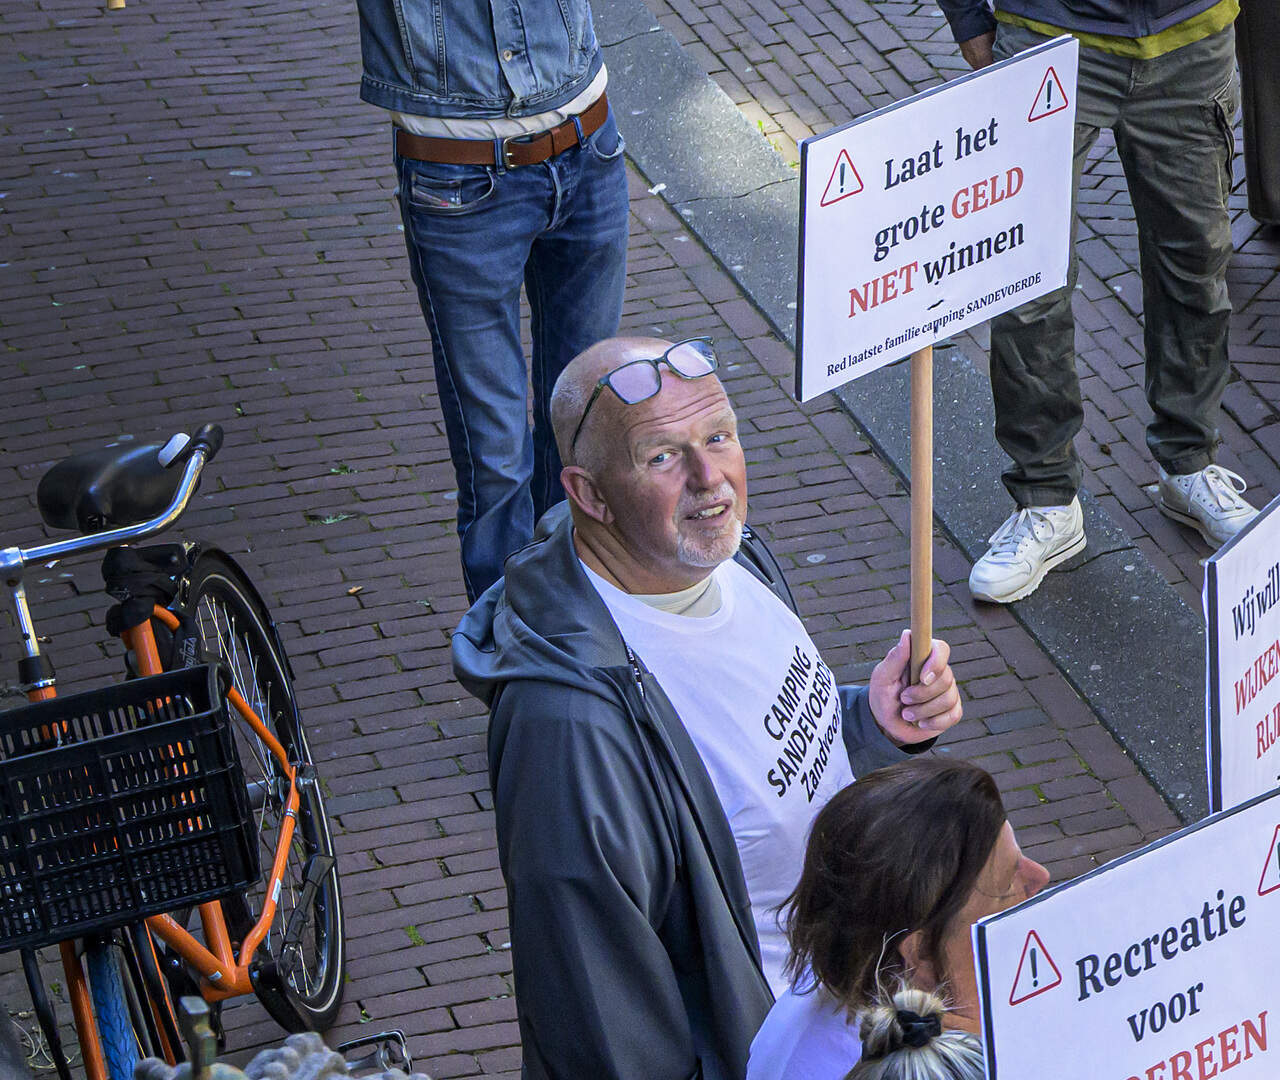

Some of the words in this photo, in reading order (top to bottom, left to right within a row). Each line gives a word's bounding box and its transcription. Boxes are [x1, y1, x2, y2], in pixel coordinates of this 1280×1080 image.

[884, 139, 944, 190] Laat
[955, 118, 998, 160] het
[874, 202, 945, 262] grote
[952, 167, 1024, 219] GELD
[848, 261, 918, 318] NIET
[923, 223, 1024, 284] winnen
[827, 353, 847, 377] Red
[848, 343, 883, 370] laatste
[884, 326, 920, 352] familie
[921, 306, 965, 335] camping
[966, 272, 1042, 316] SANDEVOERDE
[1232, 585, 1257, 642] Wij
[764, 645, 812, 741] CAMPING
[1076, 889, 1247, 1002] Recreatie
[1127, 981, 1204, 1043] voor
